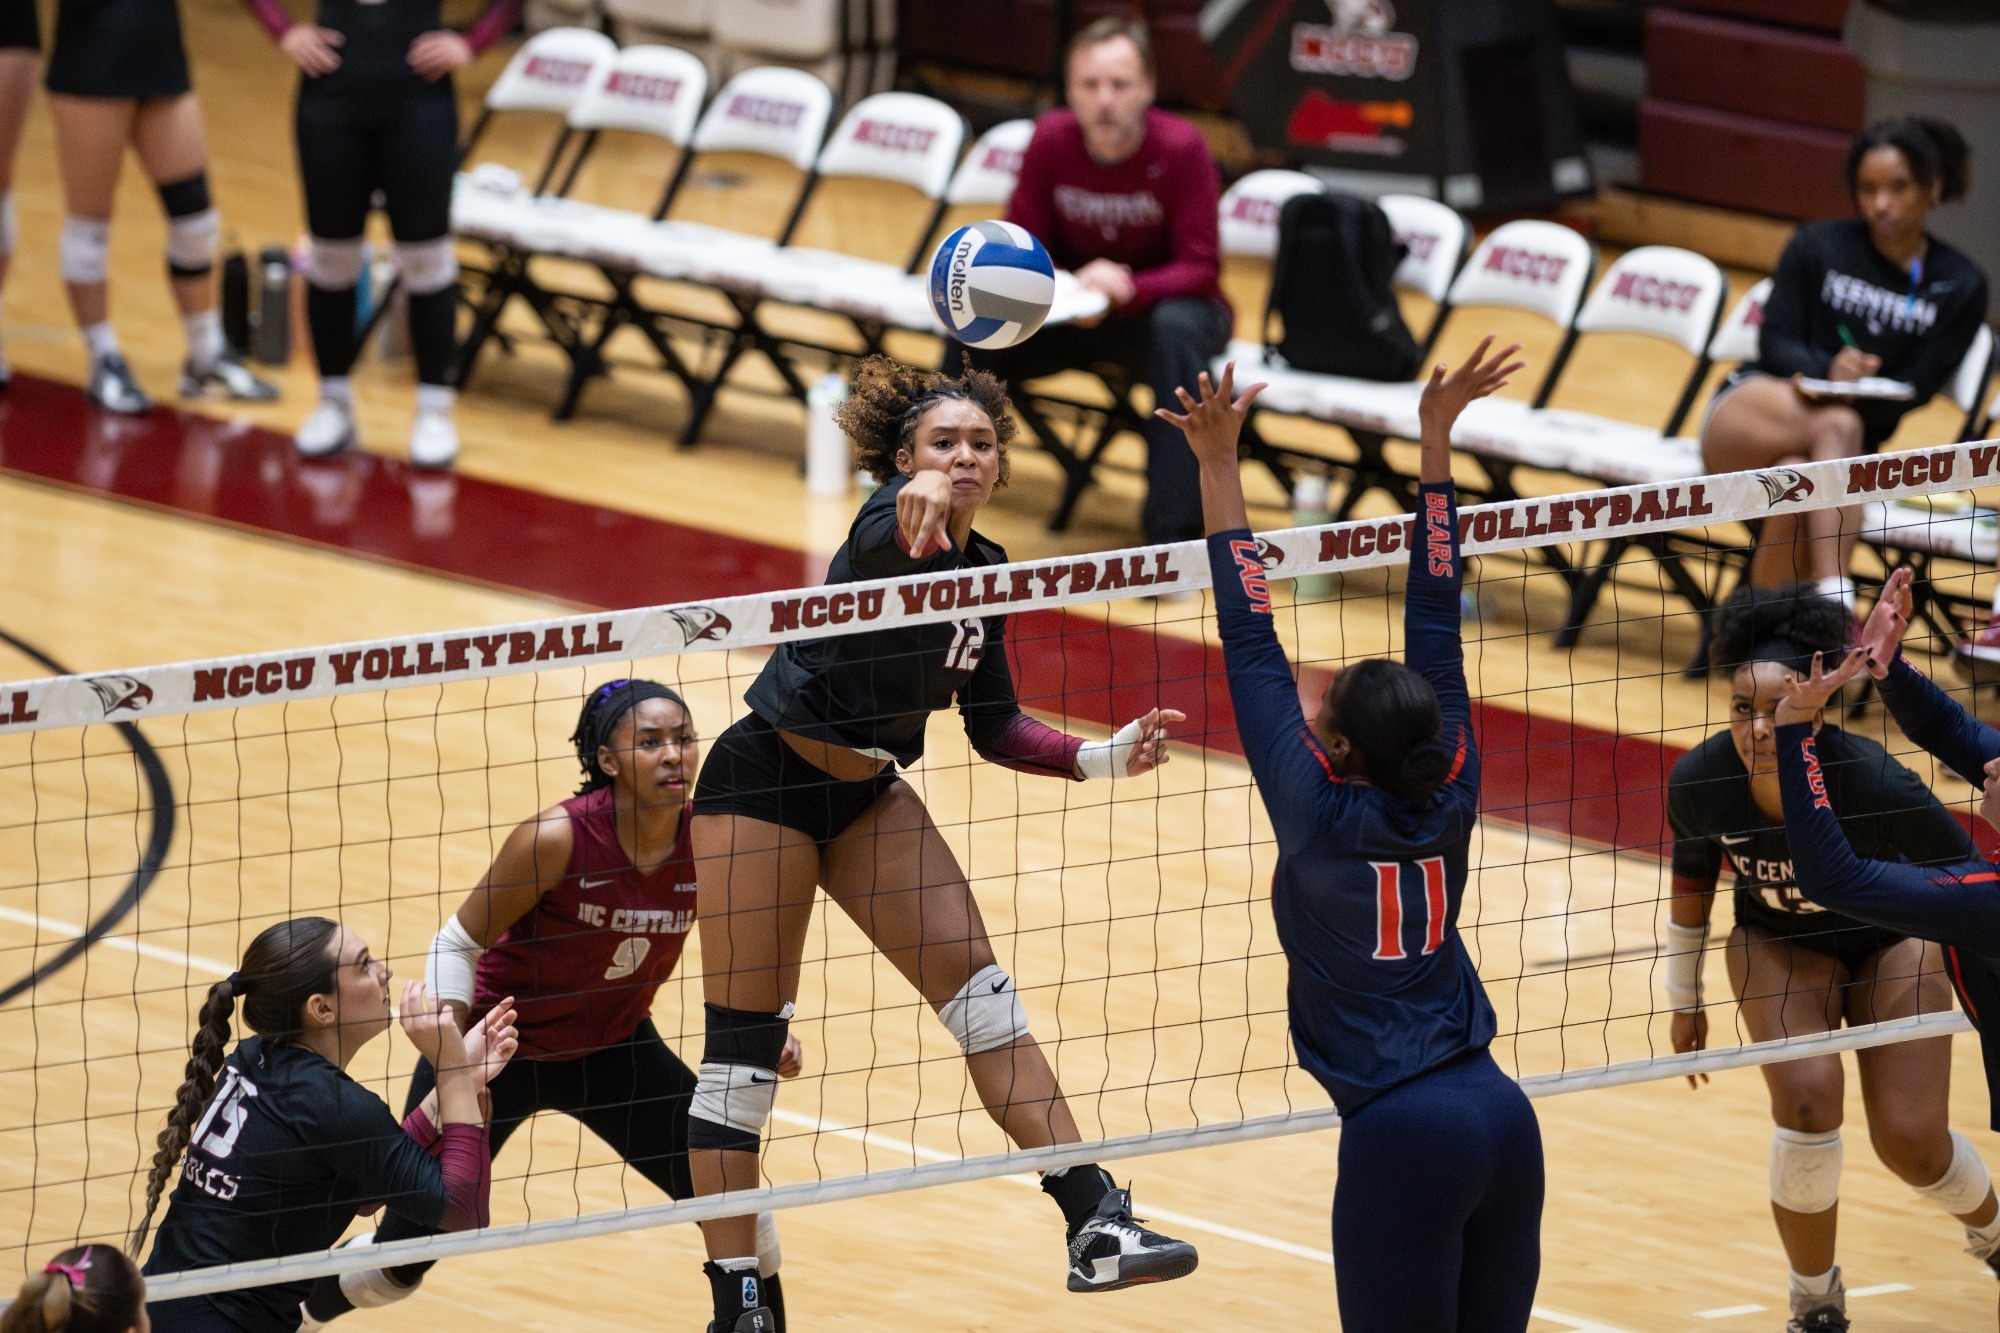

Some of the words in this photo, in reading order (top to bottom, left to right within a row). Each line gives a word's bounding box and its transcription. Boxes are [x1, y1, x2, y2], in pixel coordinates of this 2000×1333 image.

[950, 241, 972, 313] molten
[1847, 450, 1956, 494] NCCU
[1969, 446, 2000, 478] V
[1425, 492, 1454, 577] BEARS
[769, 588, 886, 633] NCCU
[898, 551, 1180, 616] VOLLEYBALL
[1230, 539, 1271, 614] LADY
[193, 657, 316, 702] NCCU
[328, 620, 623, 686] VOLLEYBALL
[943, 617, 985, 672] 12
[1801, 737, 1832, 810] LADY
[1367, 855, 1448, 961] 11
[604, 937, 652, 980] 9
